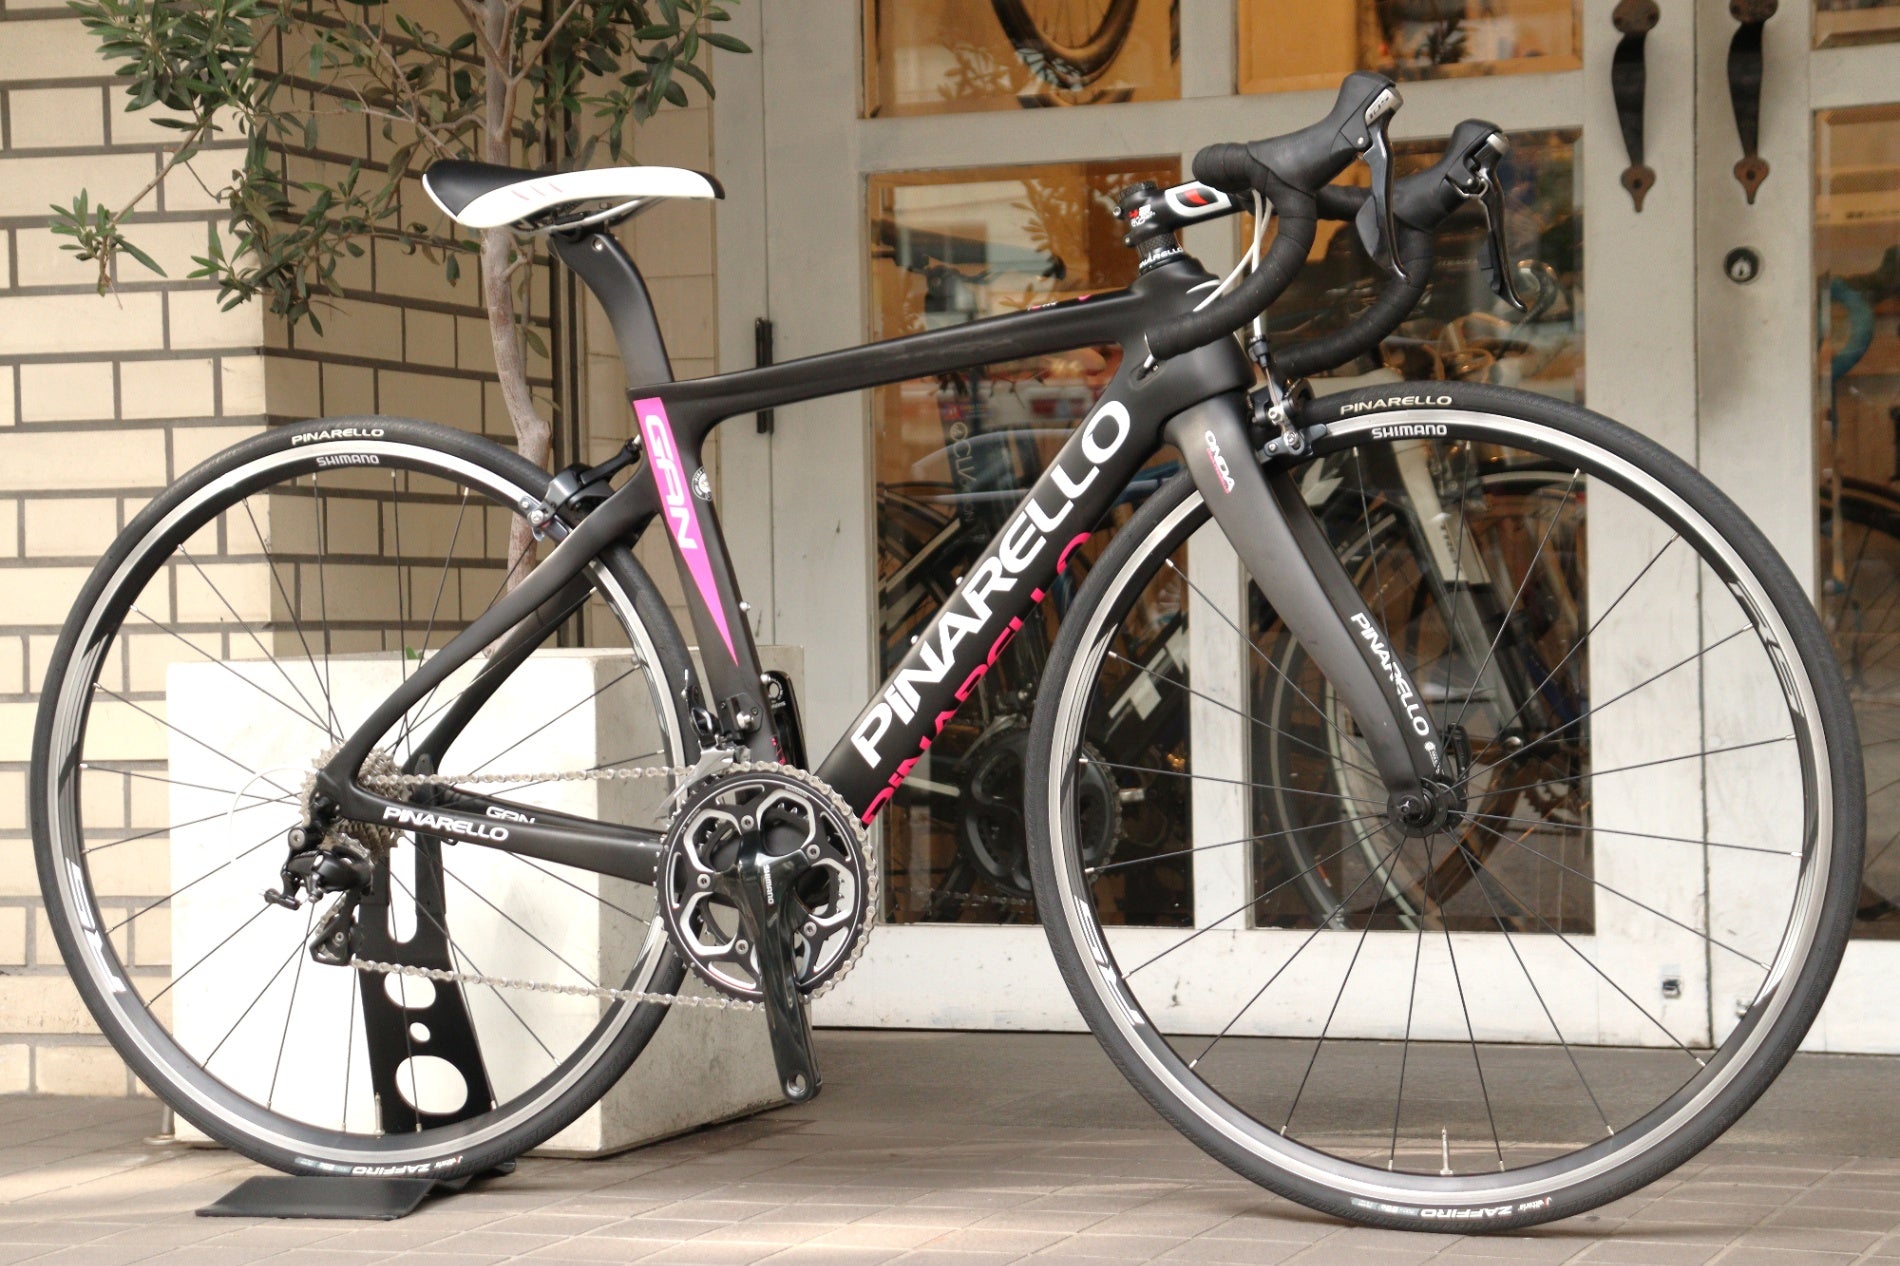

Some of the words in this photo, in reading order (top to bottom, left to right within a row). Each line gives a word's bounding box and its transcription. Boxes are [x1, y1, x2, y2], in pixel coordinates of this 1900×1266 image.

[1340, 395, 1453, 416] PINARELLO
[291, 428, 385, 446] PINARELLO
[1371, 424, 1448, 439] SHIMANO
[316, 454, 380, 467] SHIMANO
[1205, 430, 1235, 493] ONDA
[645, 414, 699, 549] GAN
[850, 400, 1131, 769] PINARELLO
[1351, 612, 1430, 737] PINARELLO
[383, 806, 510, 841] PINARELLO
[763, 864, 775, 906] SHIMANO
[352, 1163, 431, 1176] ZAFFIRO
[1420, 1205, 1513, 1218] ZAFFIRO
